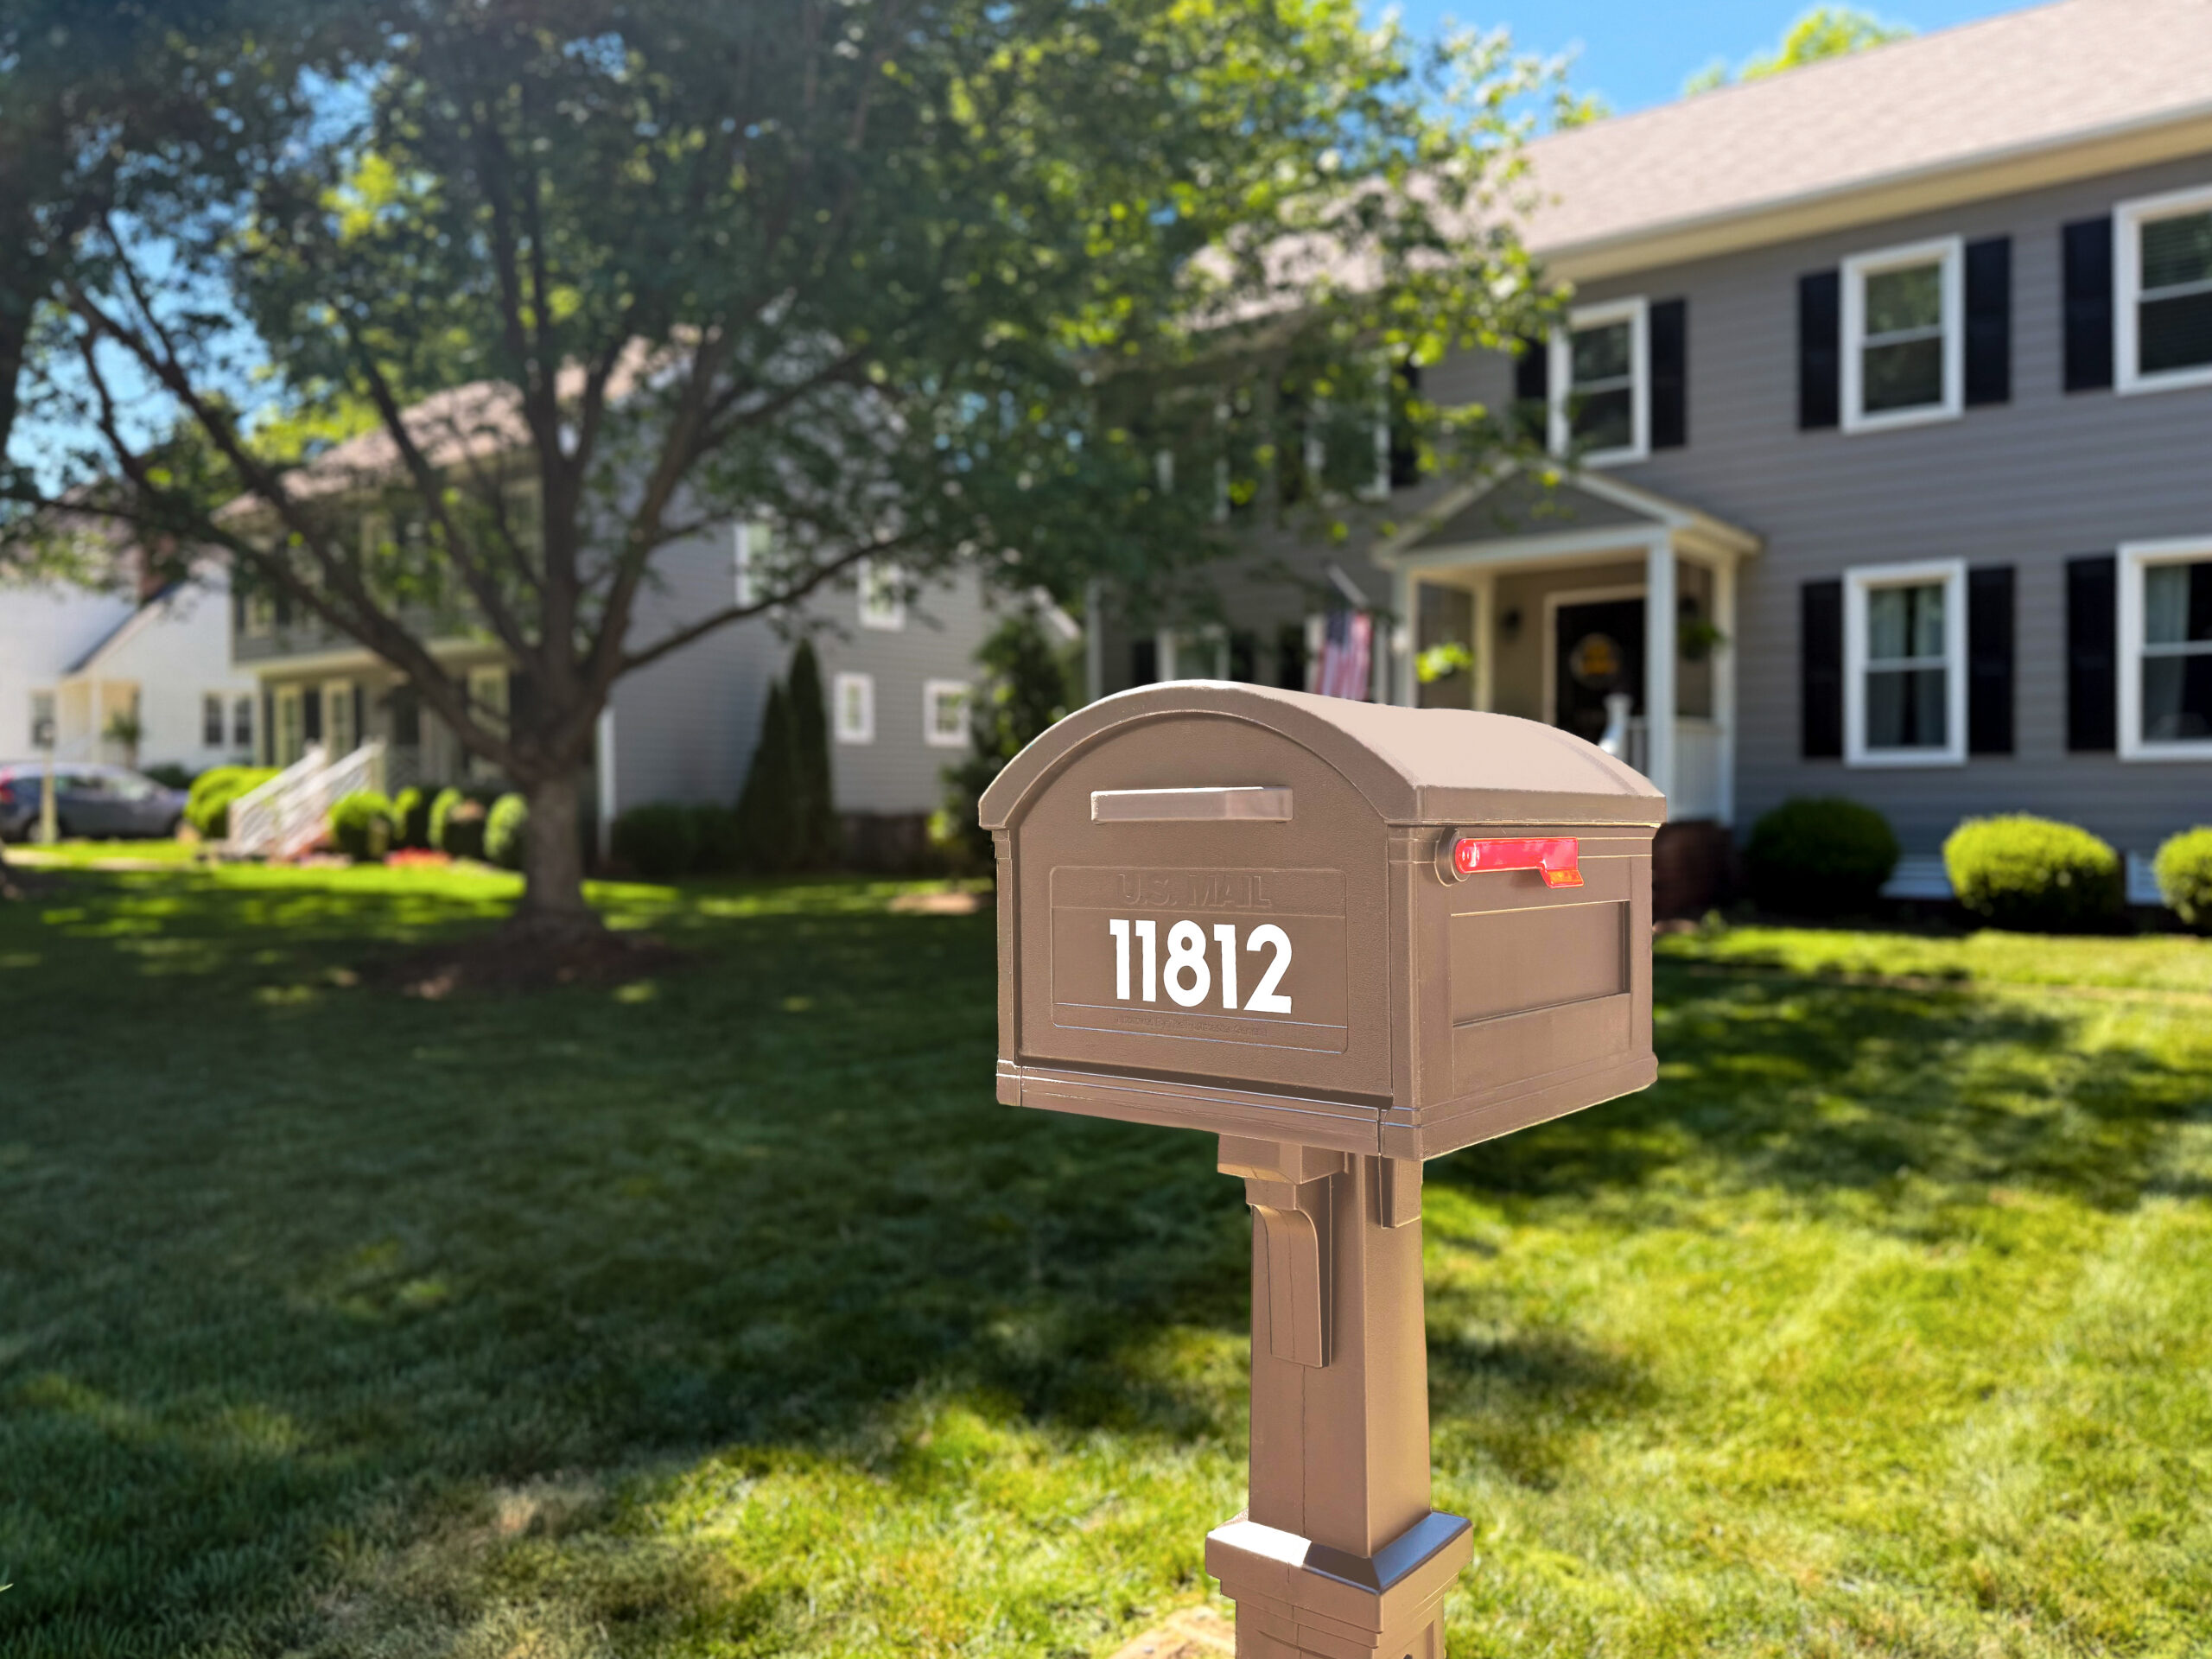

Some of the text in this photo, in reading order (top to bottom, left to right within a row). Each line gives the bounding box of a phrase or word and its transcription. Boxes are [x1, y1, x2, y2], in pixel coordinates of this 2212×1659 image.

[1119, 873, 1273, 909] U.S. MAIL
[1109, 918, 1293, 1014] 11812
